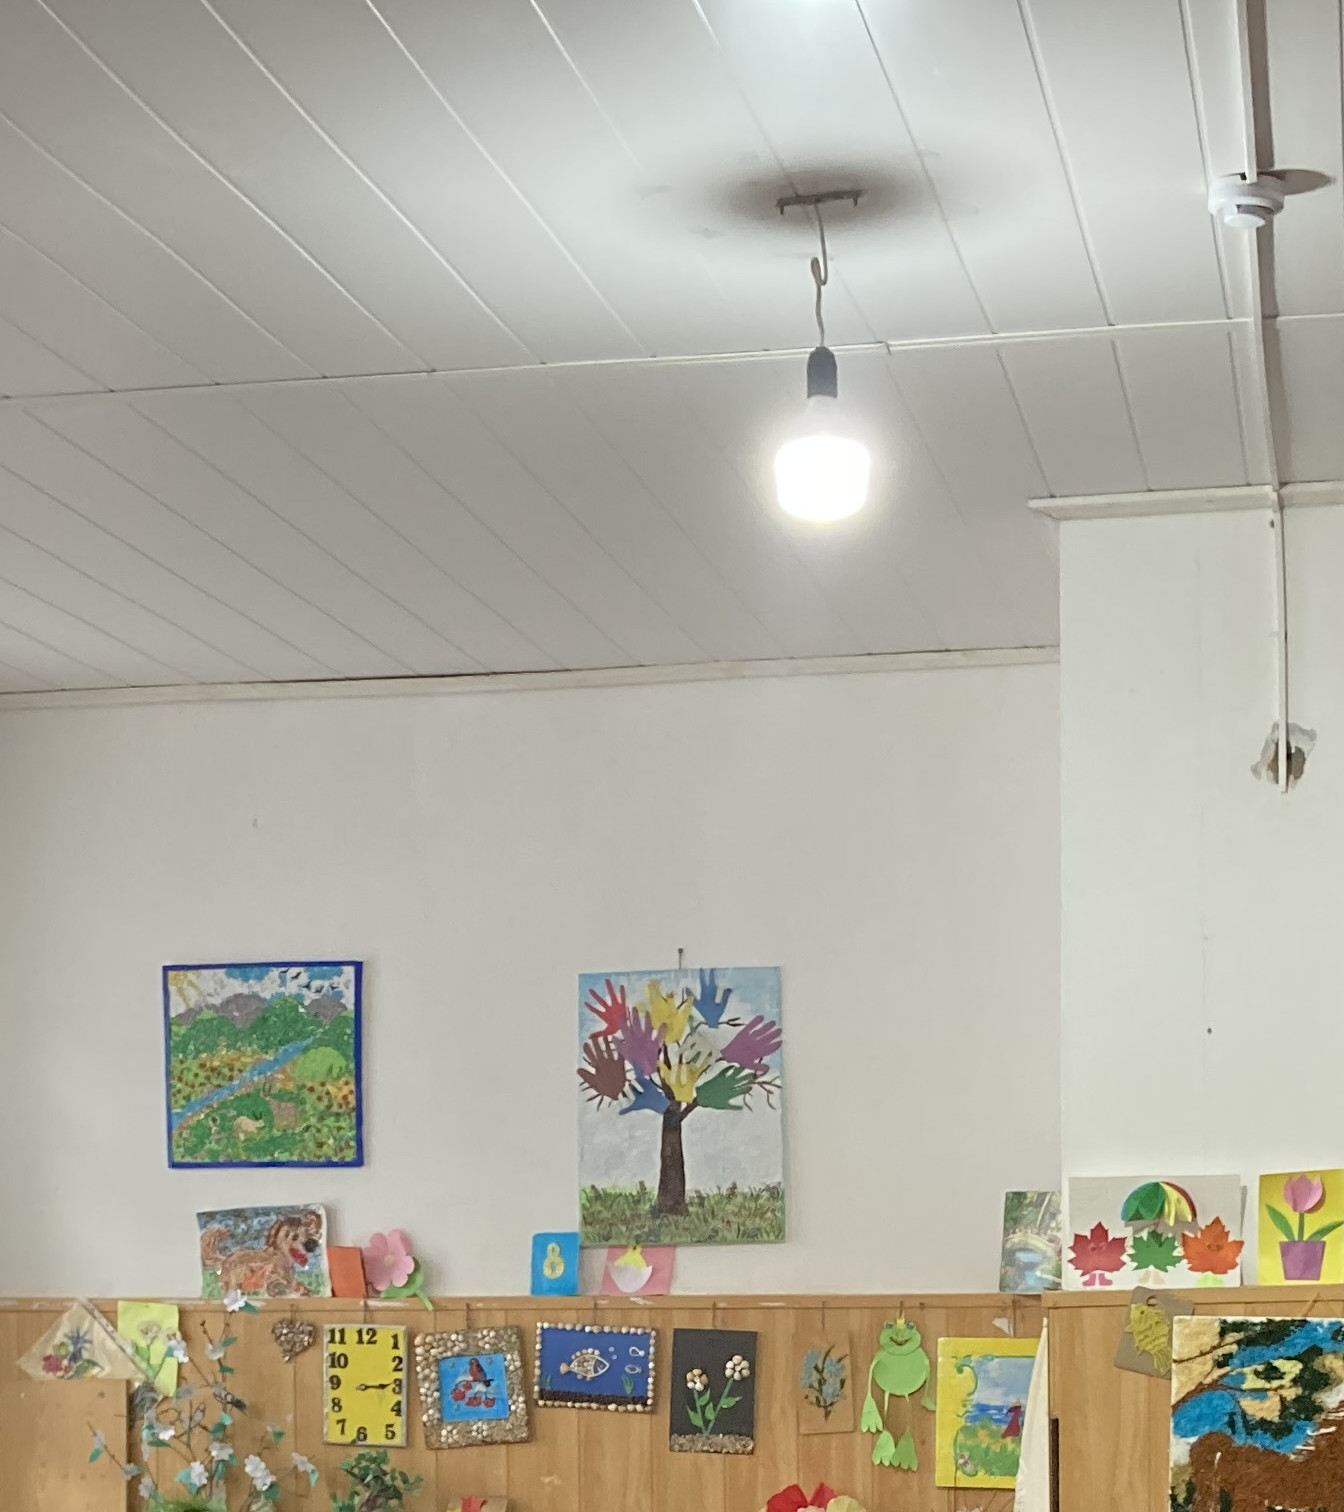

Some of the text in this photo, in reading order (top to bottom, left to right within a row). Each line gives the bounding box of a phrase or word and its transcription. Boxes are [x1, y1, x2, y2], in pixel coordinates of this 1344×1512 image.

[543, 1242, 565, 1279] 8
[328, 1327, 346, 1344] 11
[356, 1327, 376, 1344] 12
[391, 1333, 399, 1349] 1
[328, 1351, 348, 1368] 10
[392, 1356, 403, 1371] 2
[329, 1374, 341, 1389] 9
[392, 1378, 402, 1394] 3
[331, 1397, 342, 1412] 8
[390, 1400, 401, 1416] 4
[335, 1418, 346, 1435] 7
[356, 1426, 367, 1441] 6
[384, 1423, 395, 1439] 5
